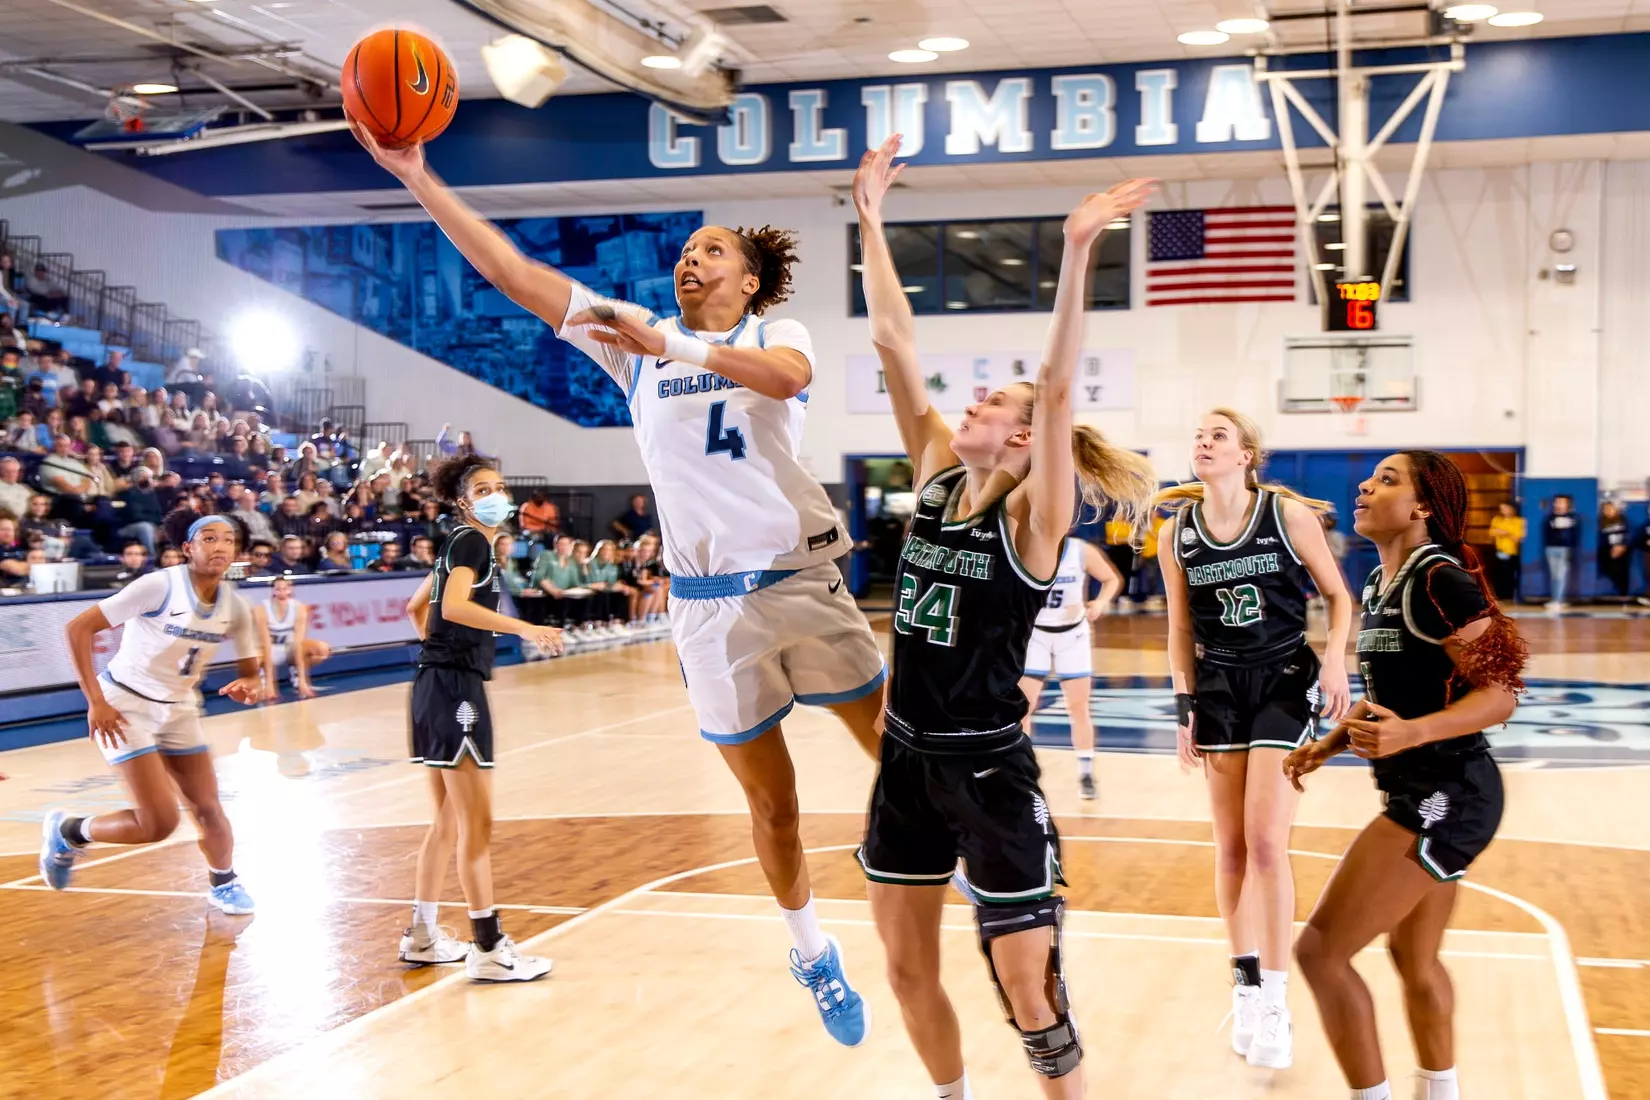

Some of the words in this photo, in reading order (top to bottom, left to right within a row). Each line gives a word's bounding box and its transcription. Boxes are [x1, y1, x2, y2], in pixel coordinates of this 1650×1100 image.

[648, 64, 1271, 169] COLUMBIA
[657, 372, 744, 399] COLUM
[705, 400, 746, 461] 4
[1187, 553, 1279, 585] DARTMOUTH
[1216, 584, 1262, 626] 12
